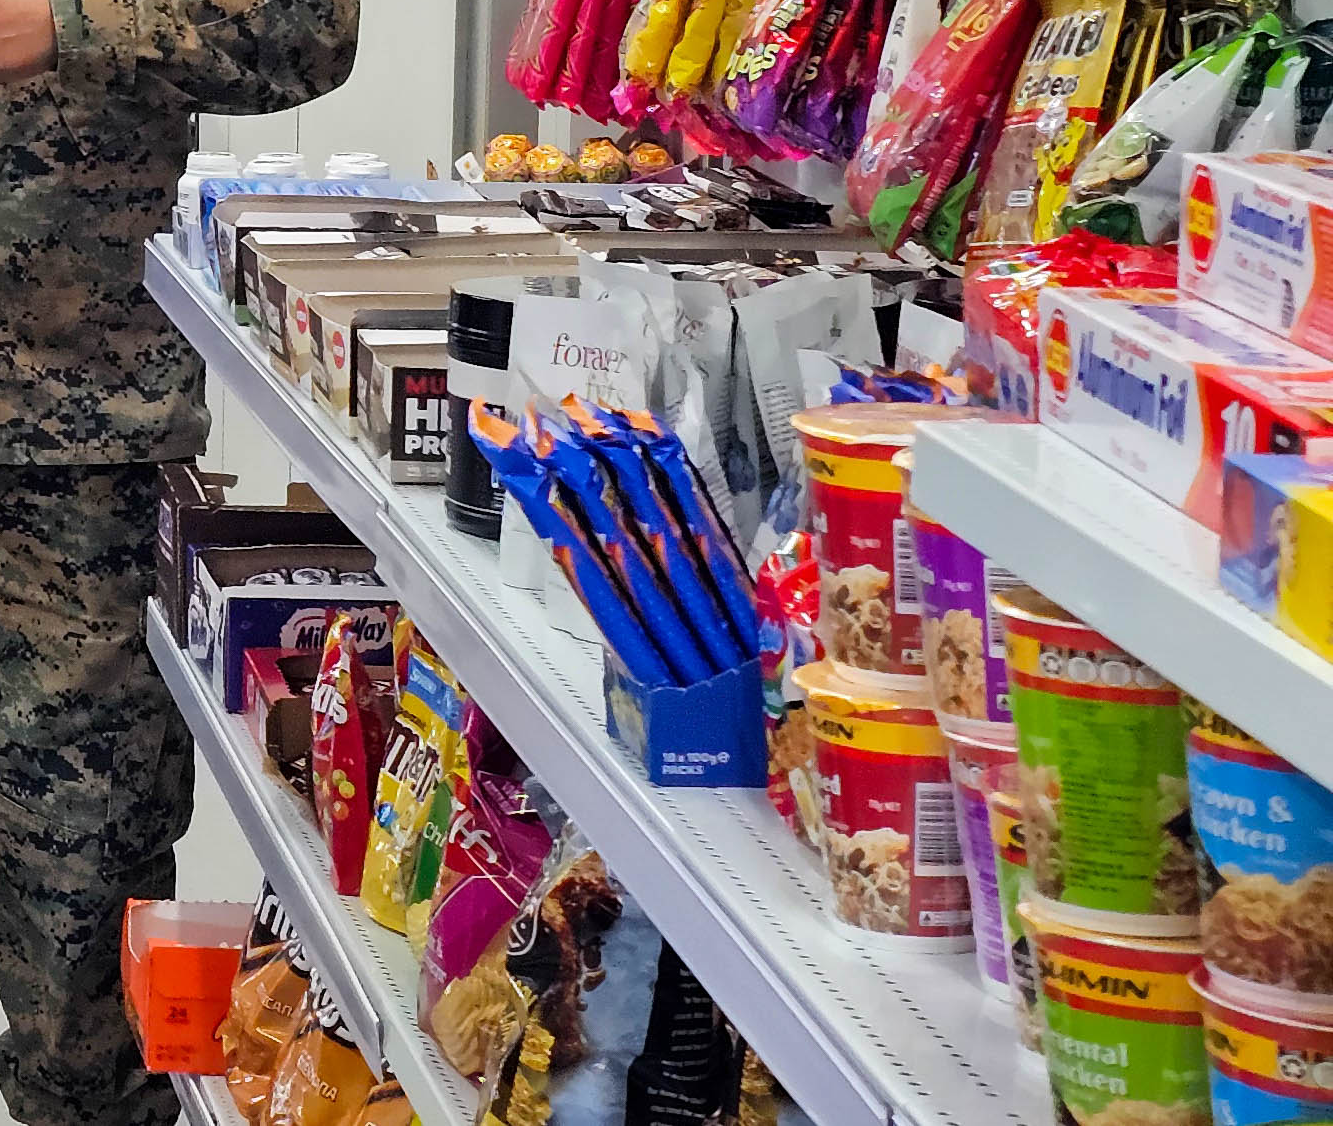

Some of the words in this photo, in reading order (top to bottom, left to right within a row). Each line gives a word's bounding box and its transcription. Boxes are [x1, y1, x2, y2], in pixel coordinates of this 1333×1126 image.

[404, 375, 448, 395] MU
[294, 625, 326, 649] Mil
[1051, 1033, 1129, 1068] ental
